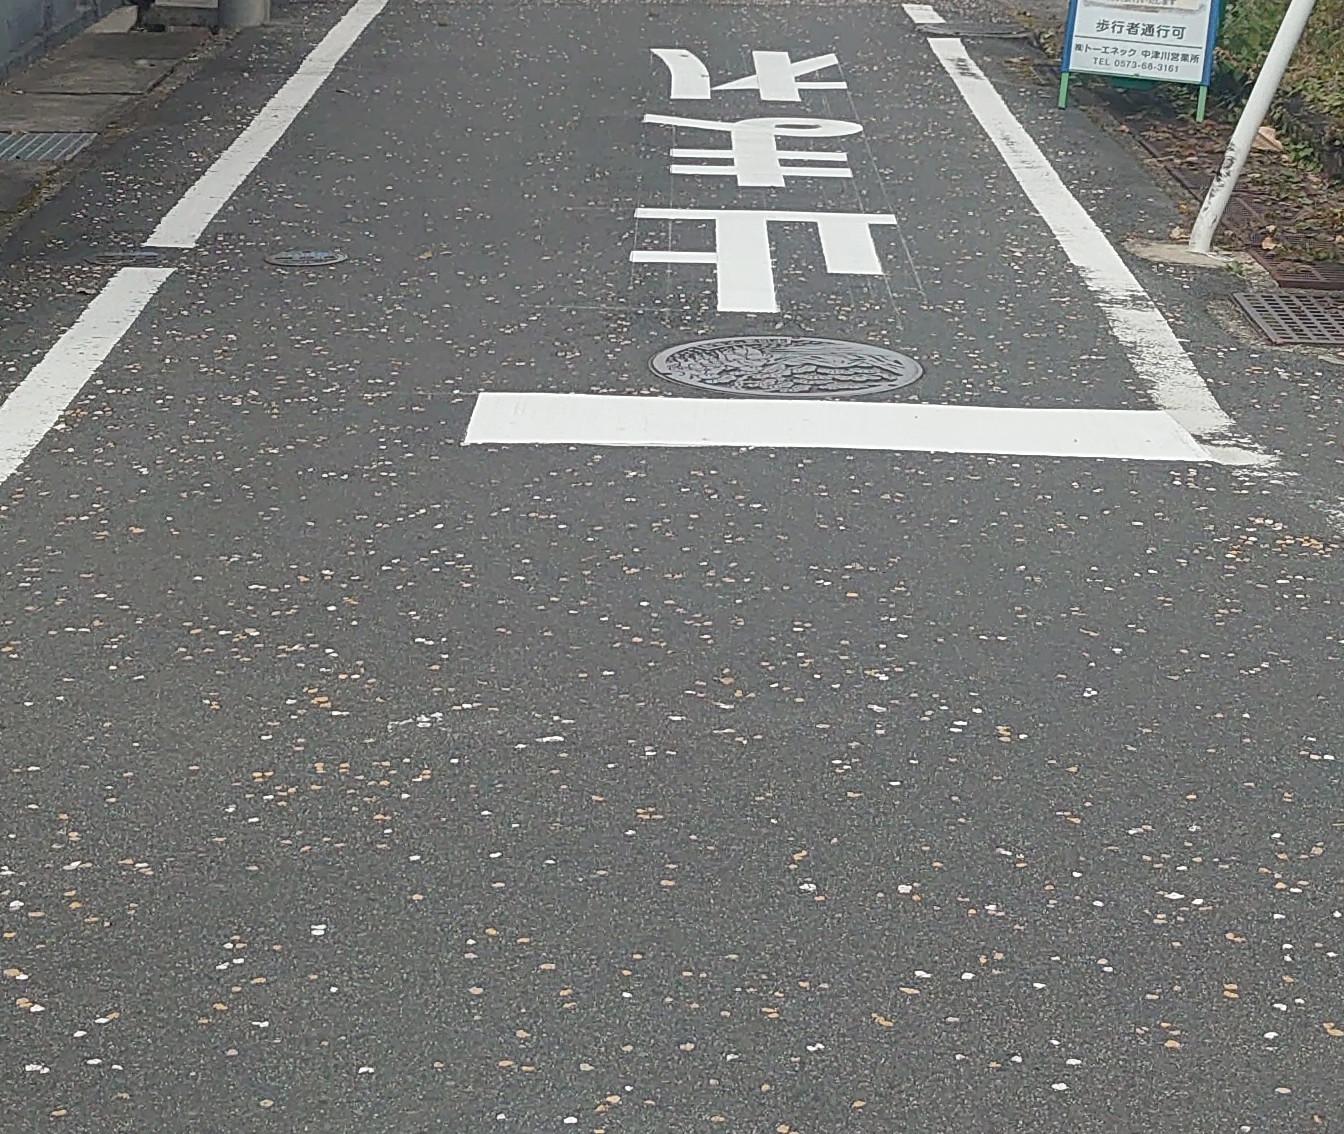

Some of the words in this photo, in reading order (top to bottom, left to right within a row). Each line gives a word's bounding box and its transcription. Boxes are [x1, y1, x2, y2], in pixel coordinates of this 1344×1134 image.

[1096, 18, 1187, 40] 歩行者通行可
[1093, 57, 1110, 66] TEL
[1141, 49, 1201, 64] 中津川営業所
